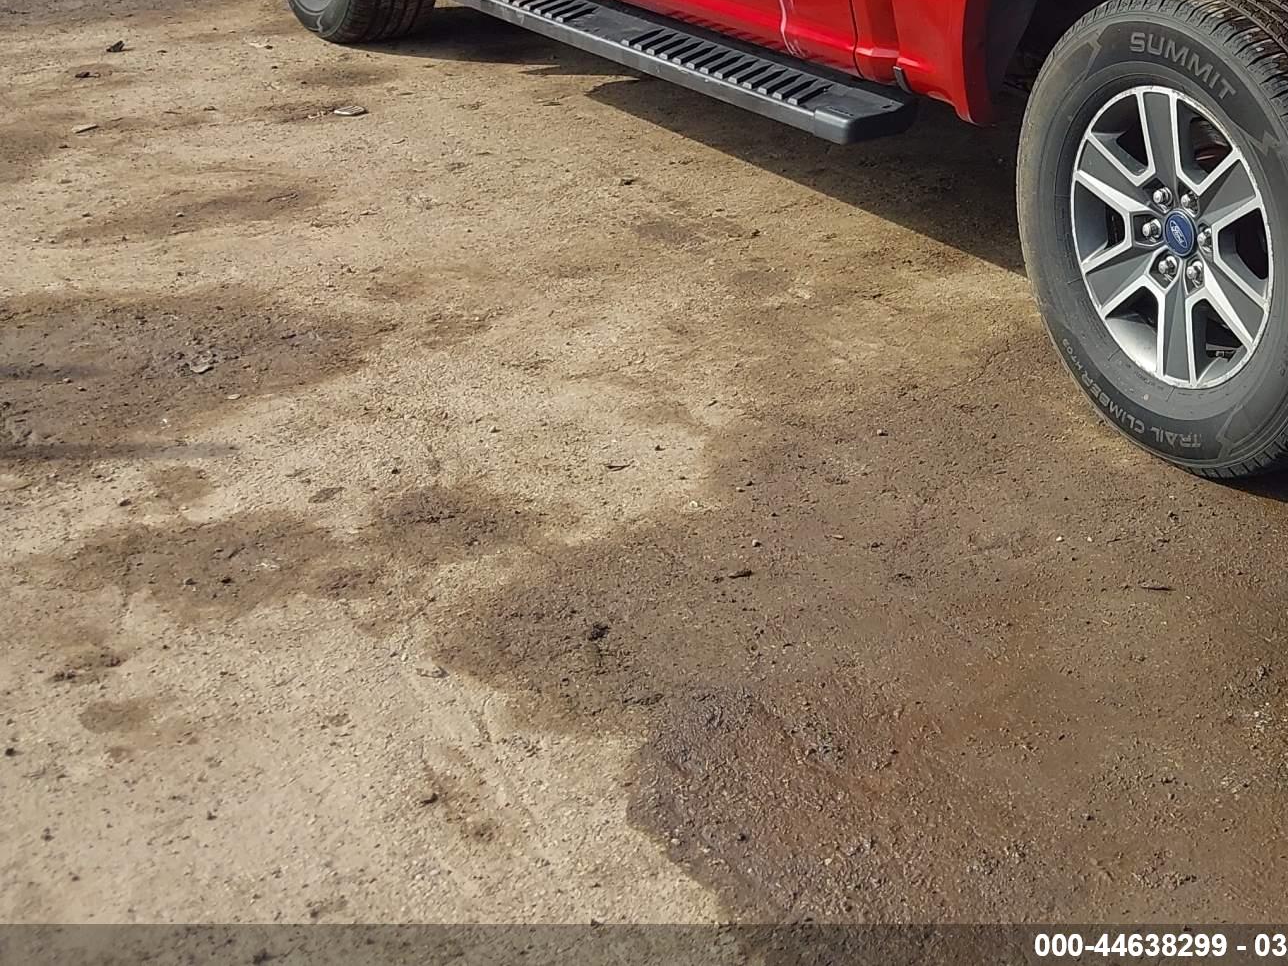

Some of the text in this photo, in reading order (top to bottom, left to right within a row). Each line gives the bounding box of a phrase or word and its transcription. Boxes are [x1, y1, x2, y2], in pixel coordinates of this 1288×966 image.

[1129, 31, 1237, 100] SUMMIT
[1082, 371, 1146, 434] CLIMBER
[1150, 425, 1202, 449] TRAIL
